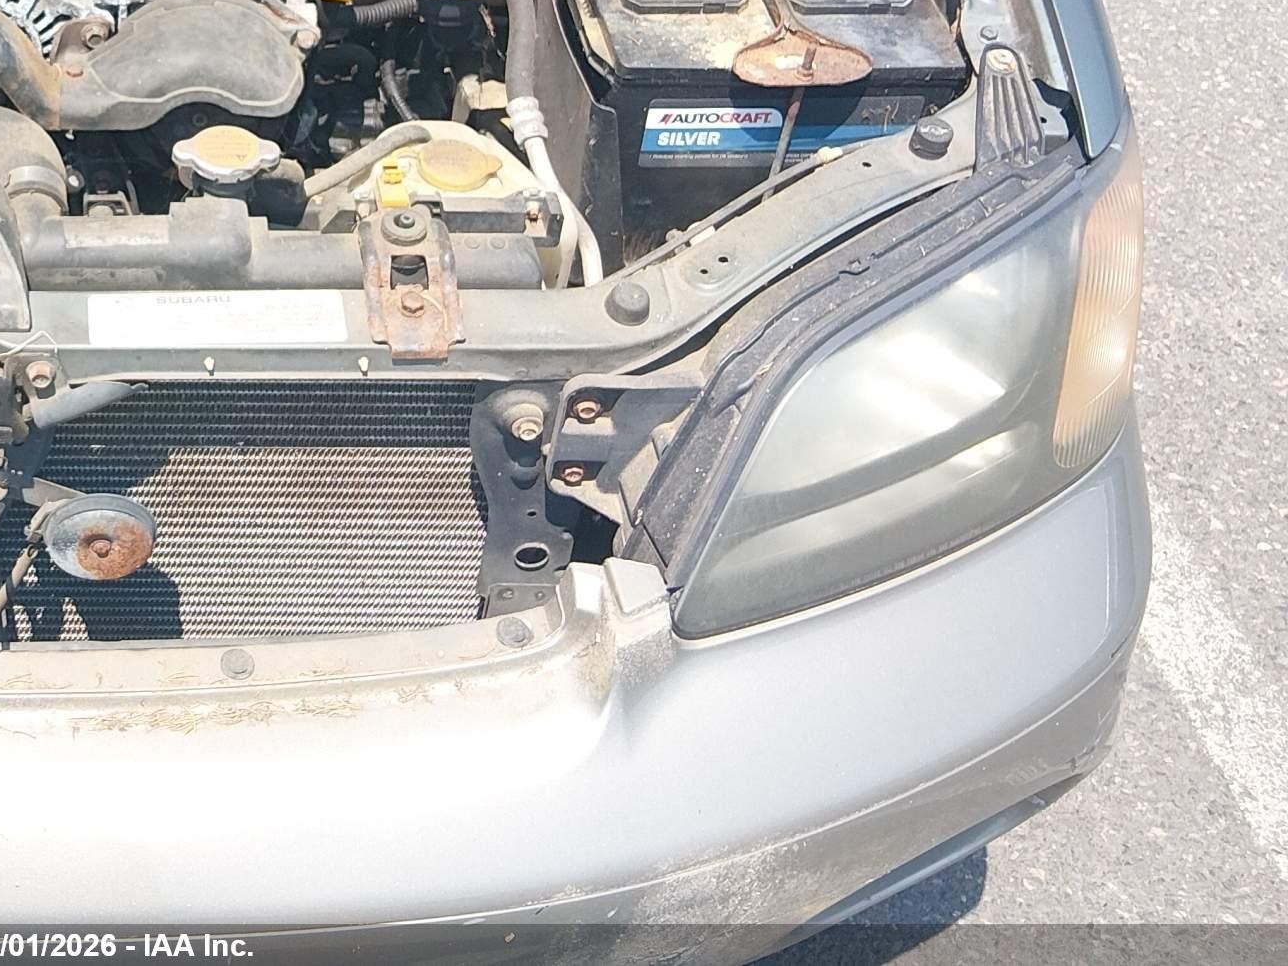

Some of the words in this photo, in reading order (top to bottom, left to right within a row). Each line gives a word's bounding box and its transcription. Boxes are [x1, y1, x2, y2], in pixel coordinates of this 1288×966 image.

[671, 112, 772, 124] AUTOCRAFT
[657, 131, 721, 146] SILVER
[155, 295, 232, 305] SUBARU
